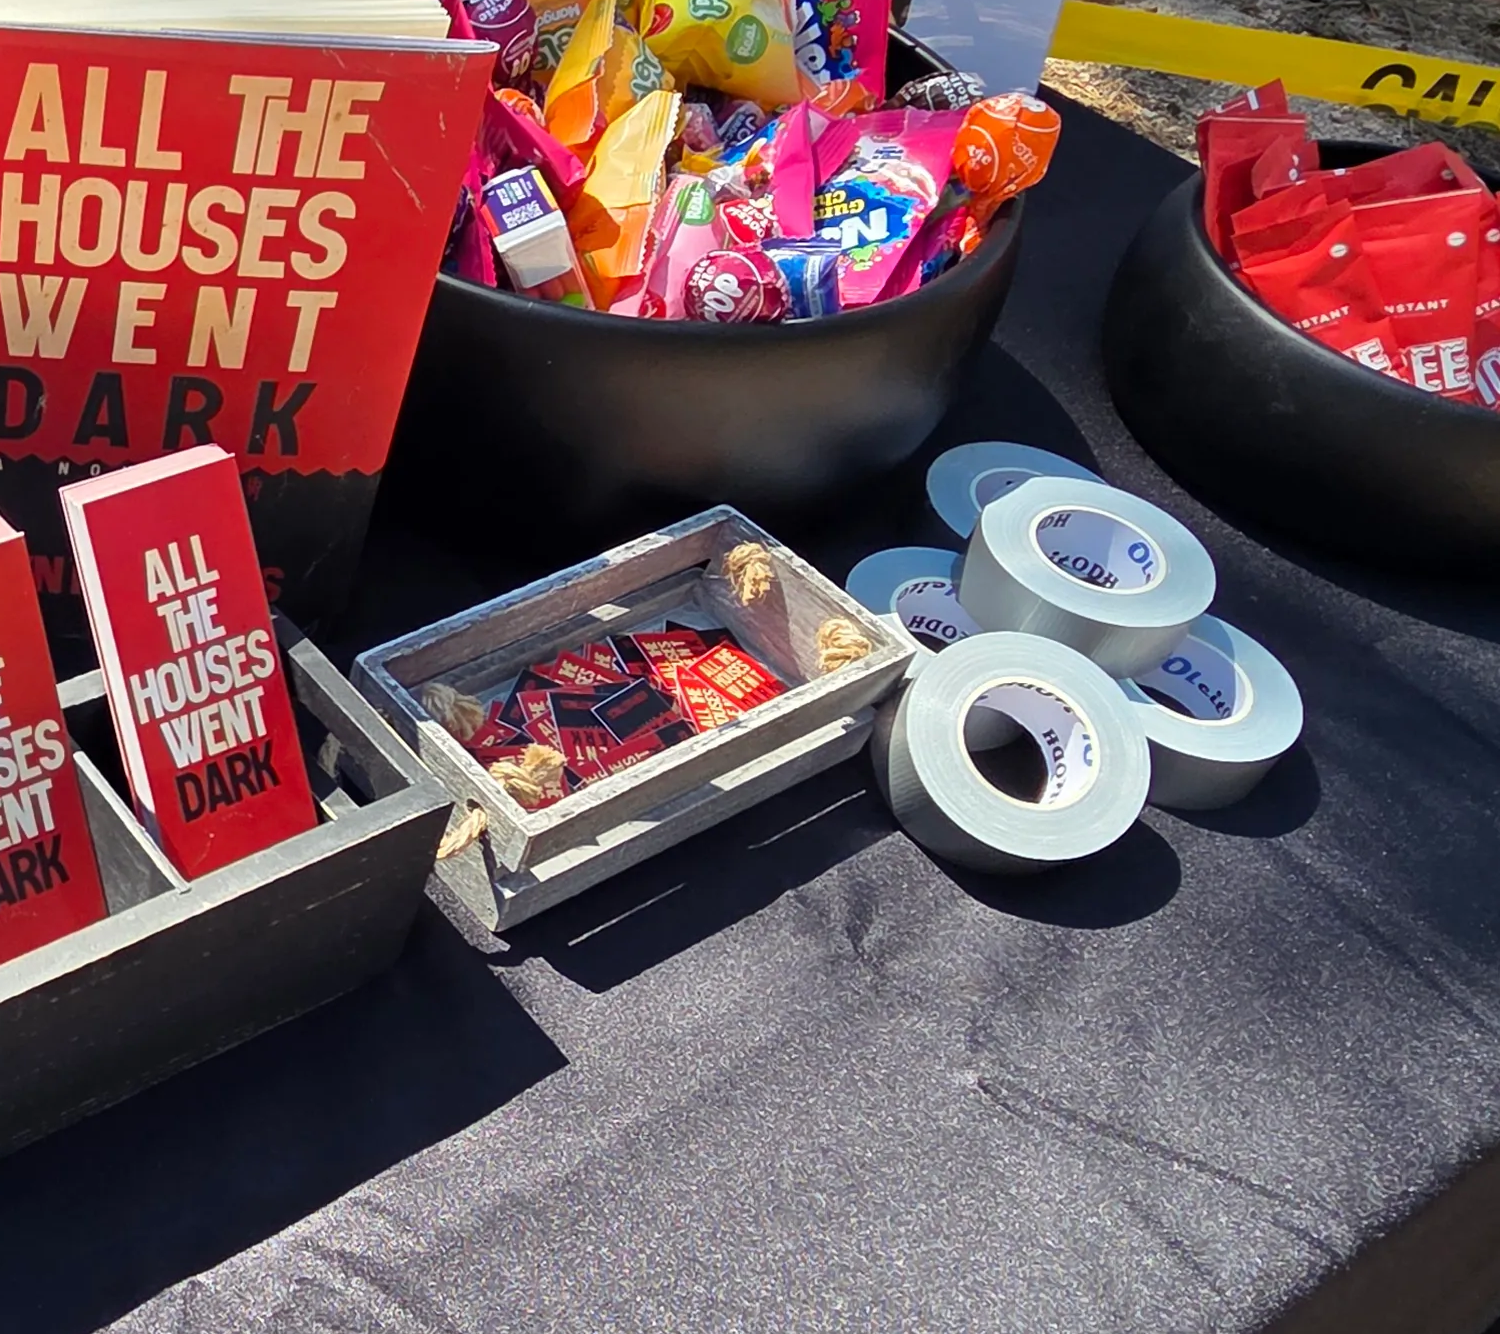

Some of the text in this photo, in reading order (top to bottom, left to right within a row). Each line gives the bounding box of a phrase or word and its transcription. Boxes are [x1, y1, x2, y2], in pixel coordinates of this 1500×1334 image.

[3, 63, 385, 180] ALL THE
[145, 534, 220, 603] ALL
[157, 587, 228, 654] THE
[130, 628, 277, 725] HOUSES
[698, 660, 724, 678] ALL
[161, 686, 270, 770] WENT
[177, 740, 281, 823] DARK
